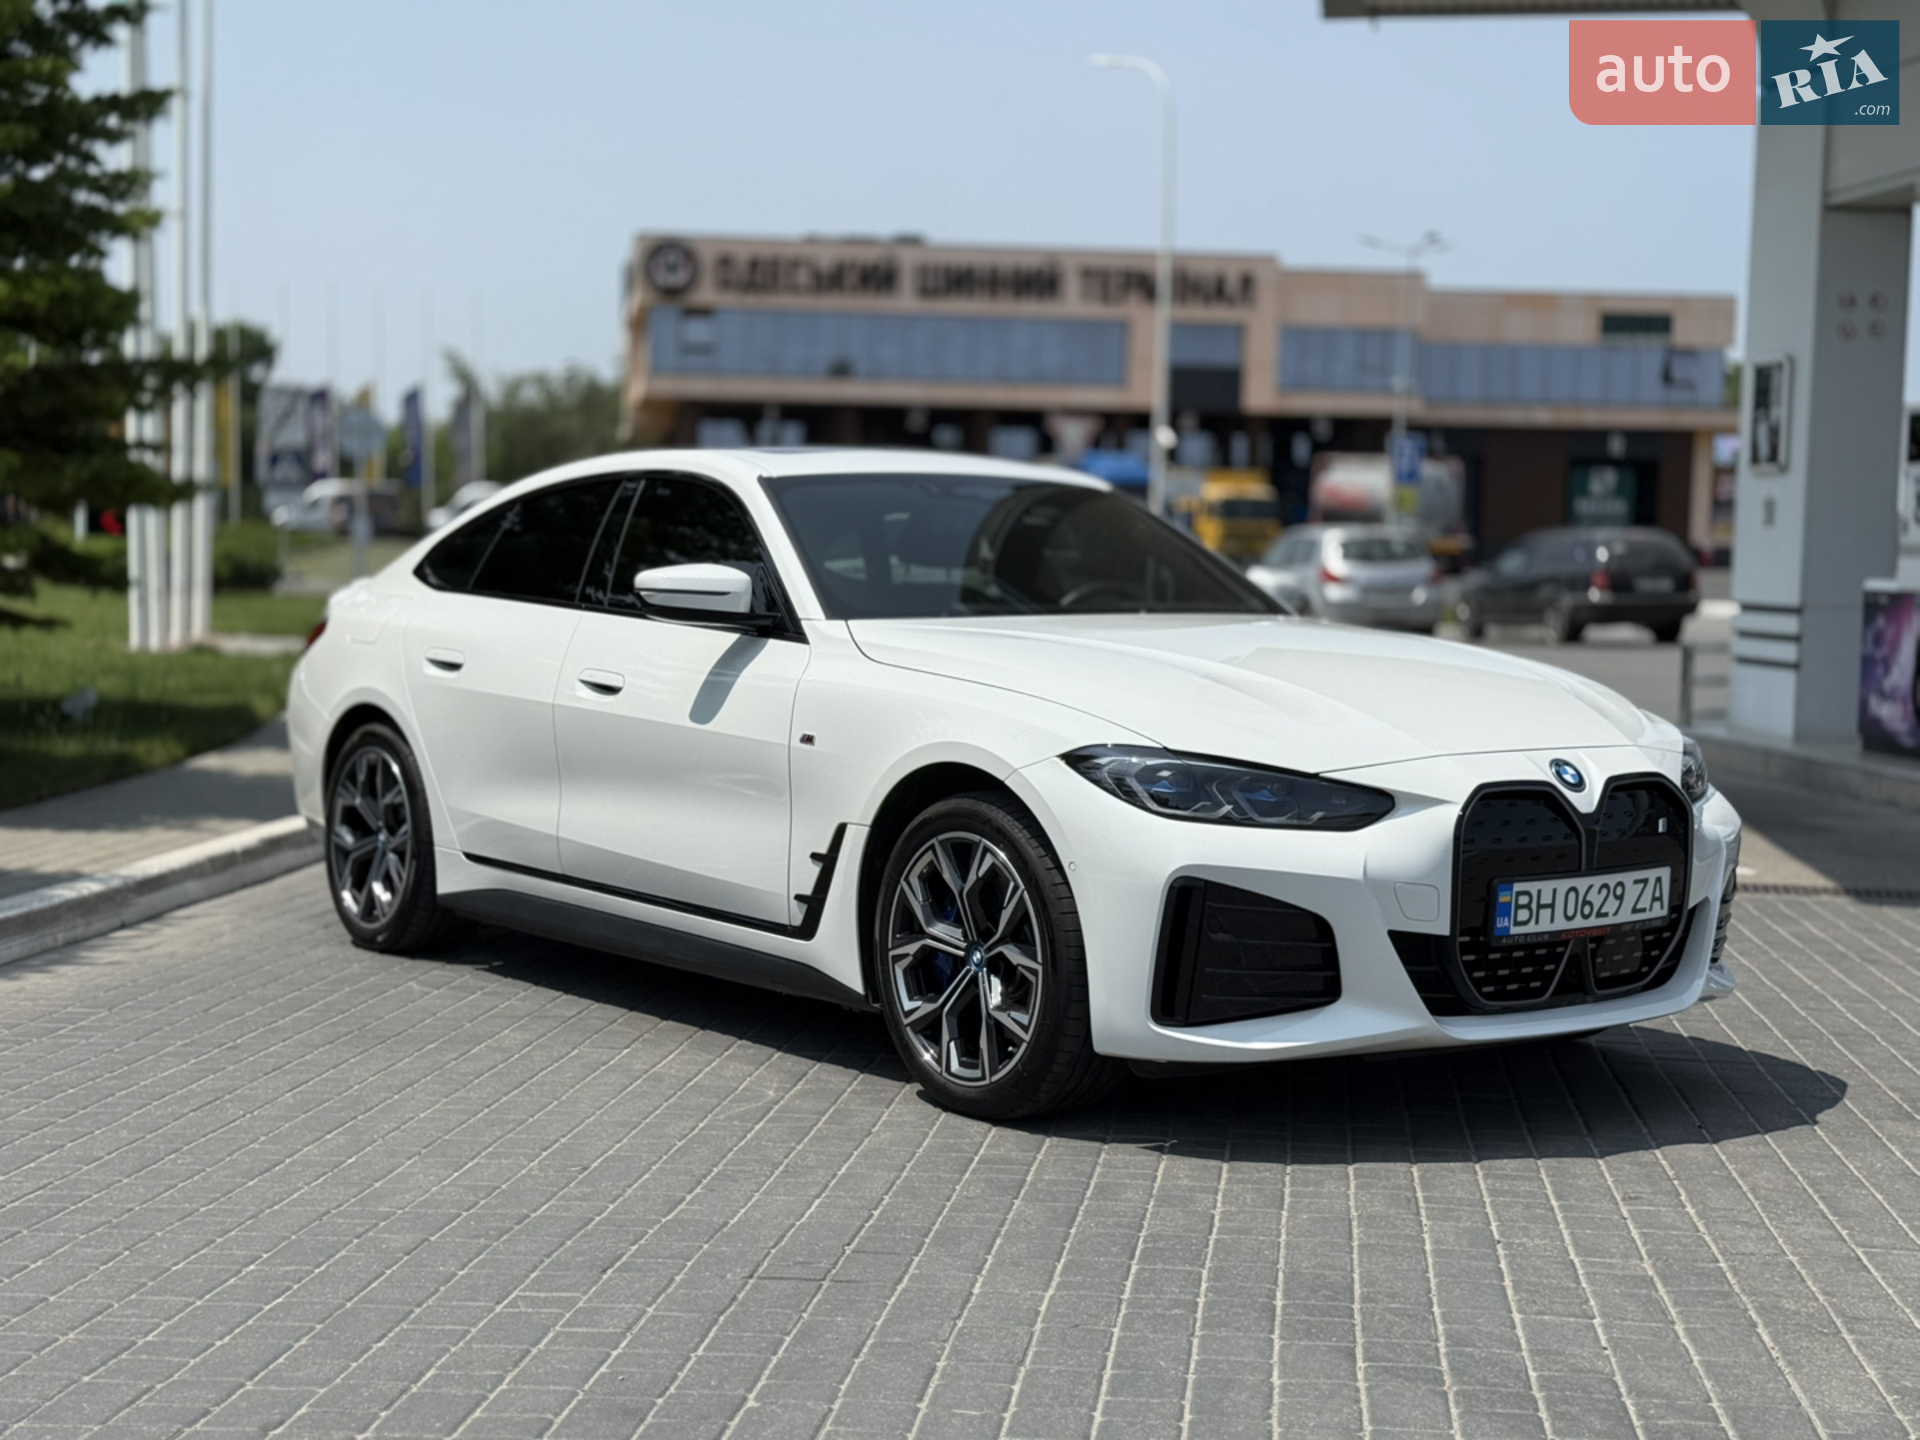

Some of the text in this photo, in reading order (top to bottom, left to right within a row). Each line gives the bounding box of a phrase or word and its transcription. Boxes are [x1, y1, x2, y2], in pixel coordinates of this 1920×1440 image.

[1512, 875, 1665, 927] BH 0629 ZA
[1497, 917, 1510, 928] UA
[1501, 936, 1525, 944] AUTO
[1527, 934, 1549, 942] CLUB
